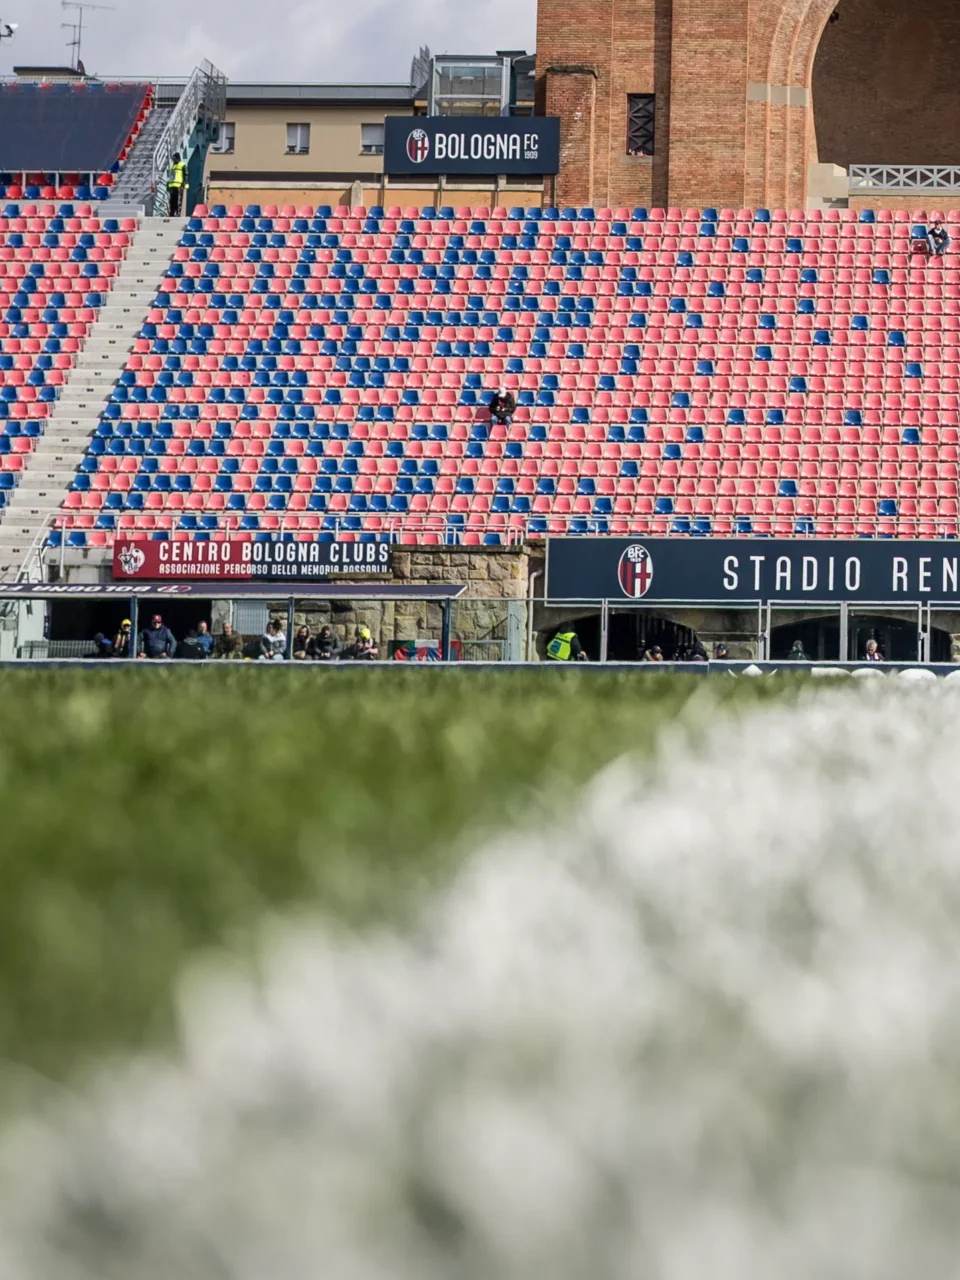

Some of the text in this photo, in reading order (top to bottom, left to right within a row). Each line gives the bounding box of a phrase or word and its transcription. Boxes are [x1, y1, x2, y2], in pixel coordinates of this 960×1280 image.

[435, 133, 538, 159] BOLOGNA FC
[524, 151, 538, 159] 1909
[159, 542, 388, 562] CENTRO BOLOGNA CLUBS
[628, 546, 644, 558] BFC
[159, 564, 221, 575] ASSOCIAZIONE
[224, 564, 268, 575] PERCORSO
[271, 564, 297, 575] DELLA
[301, 564, 339, 575] MEMORIA
[723, 555, 862, 591] STADIO
